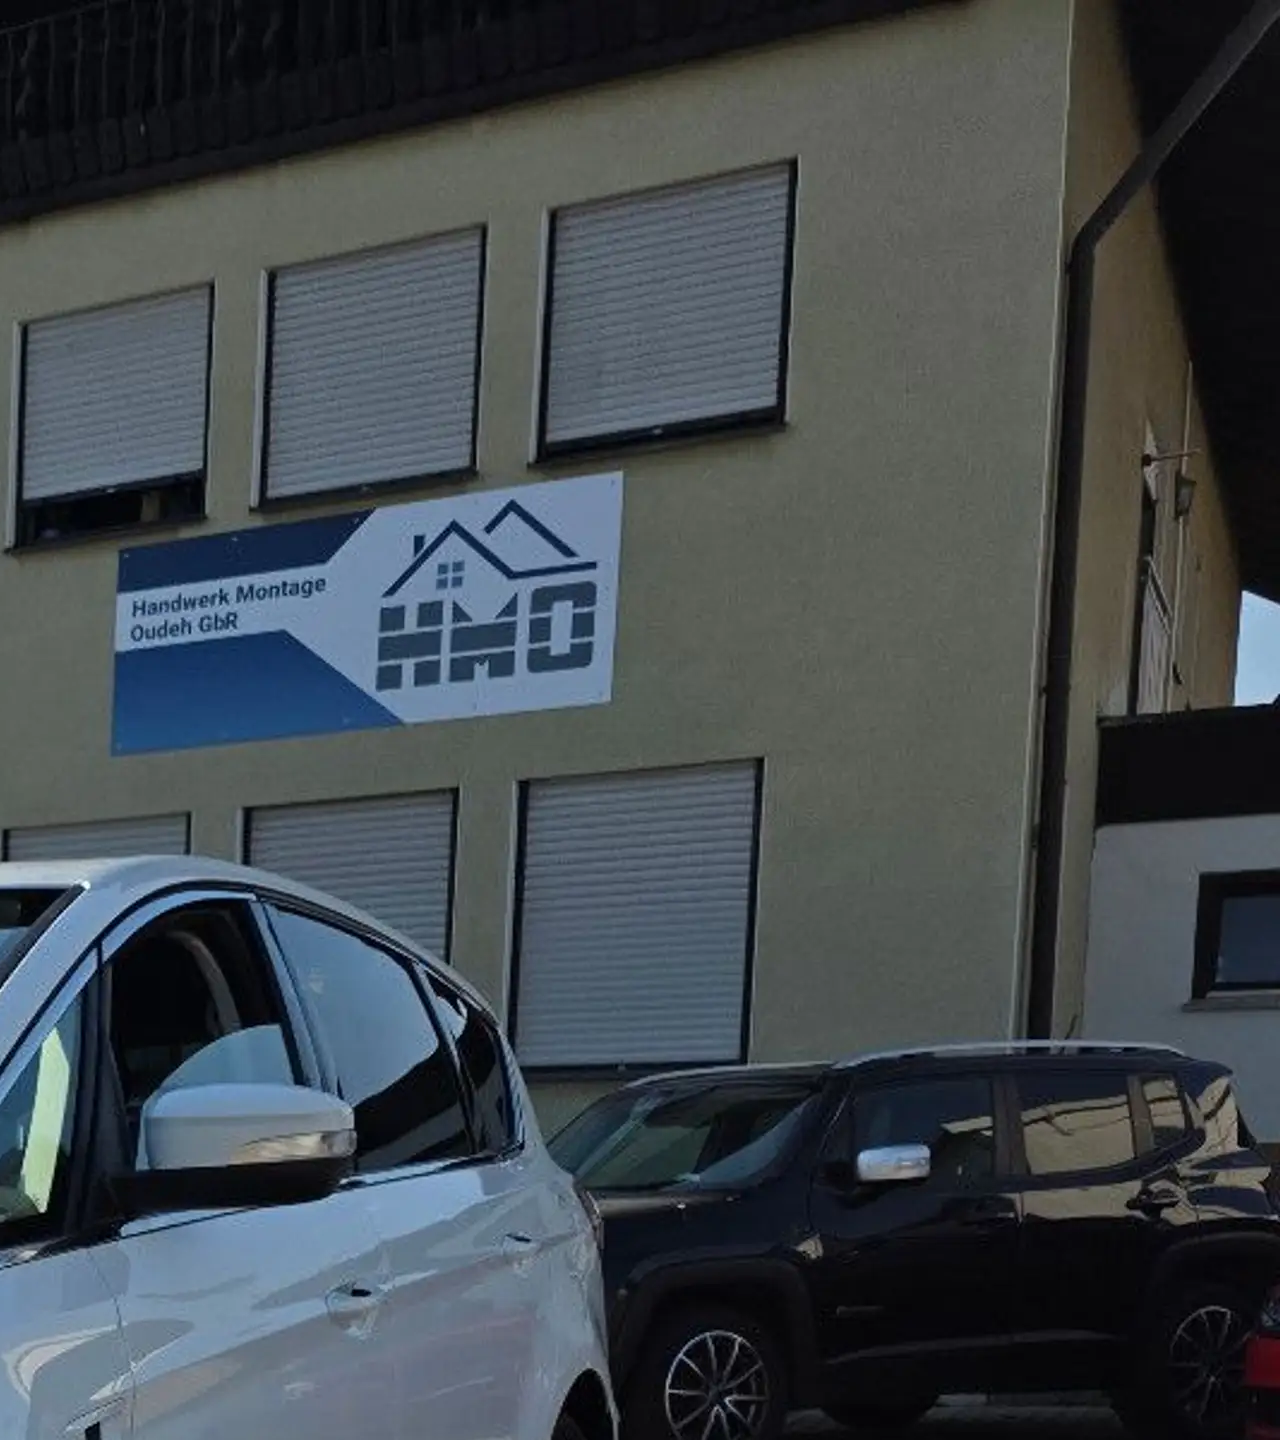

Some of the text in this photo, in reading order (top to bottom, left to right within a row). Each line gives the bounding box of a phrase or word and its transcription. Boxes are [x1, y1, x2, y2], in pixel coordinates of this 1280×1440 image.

[132, 577, 327, 618] Handwerk Montage
[130, 612, 239, 642] Oudeh GbR
[376, 580, 598, 691] HMO
